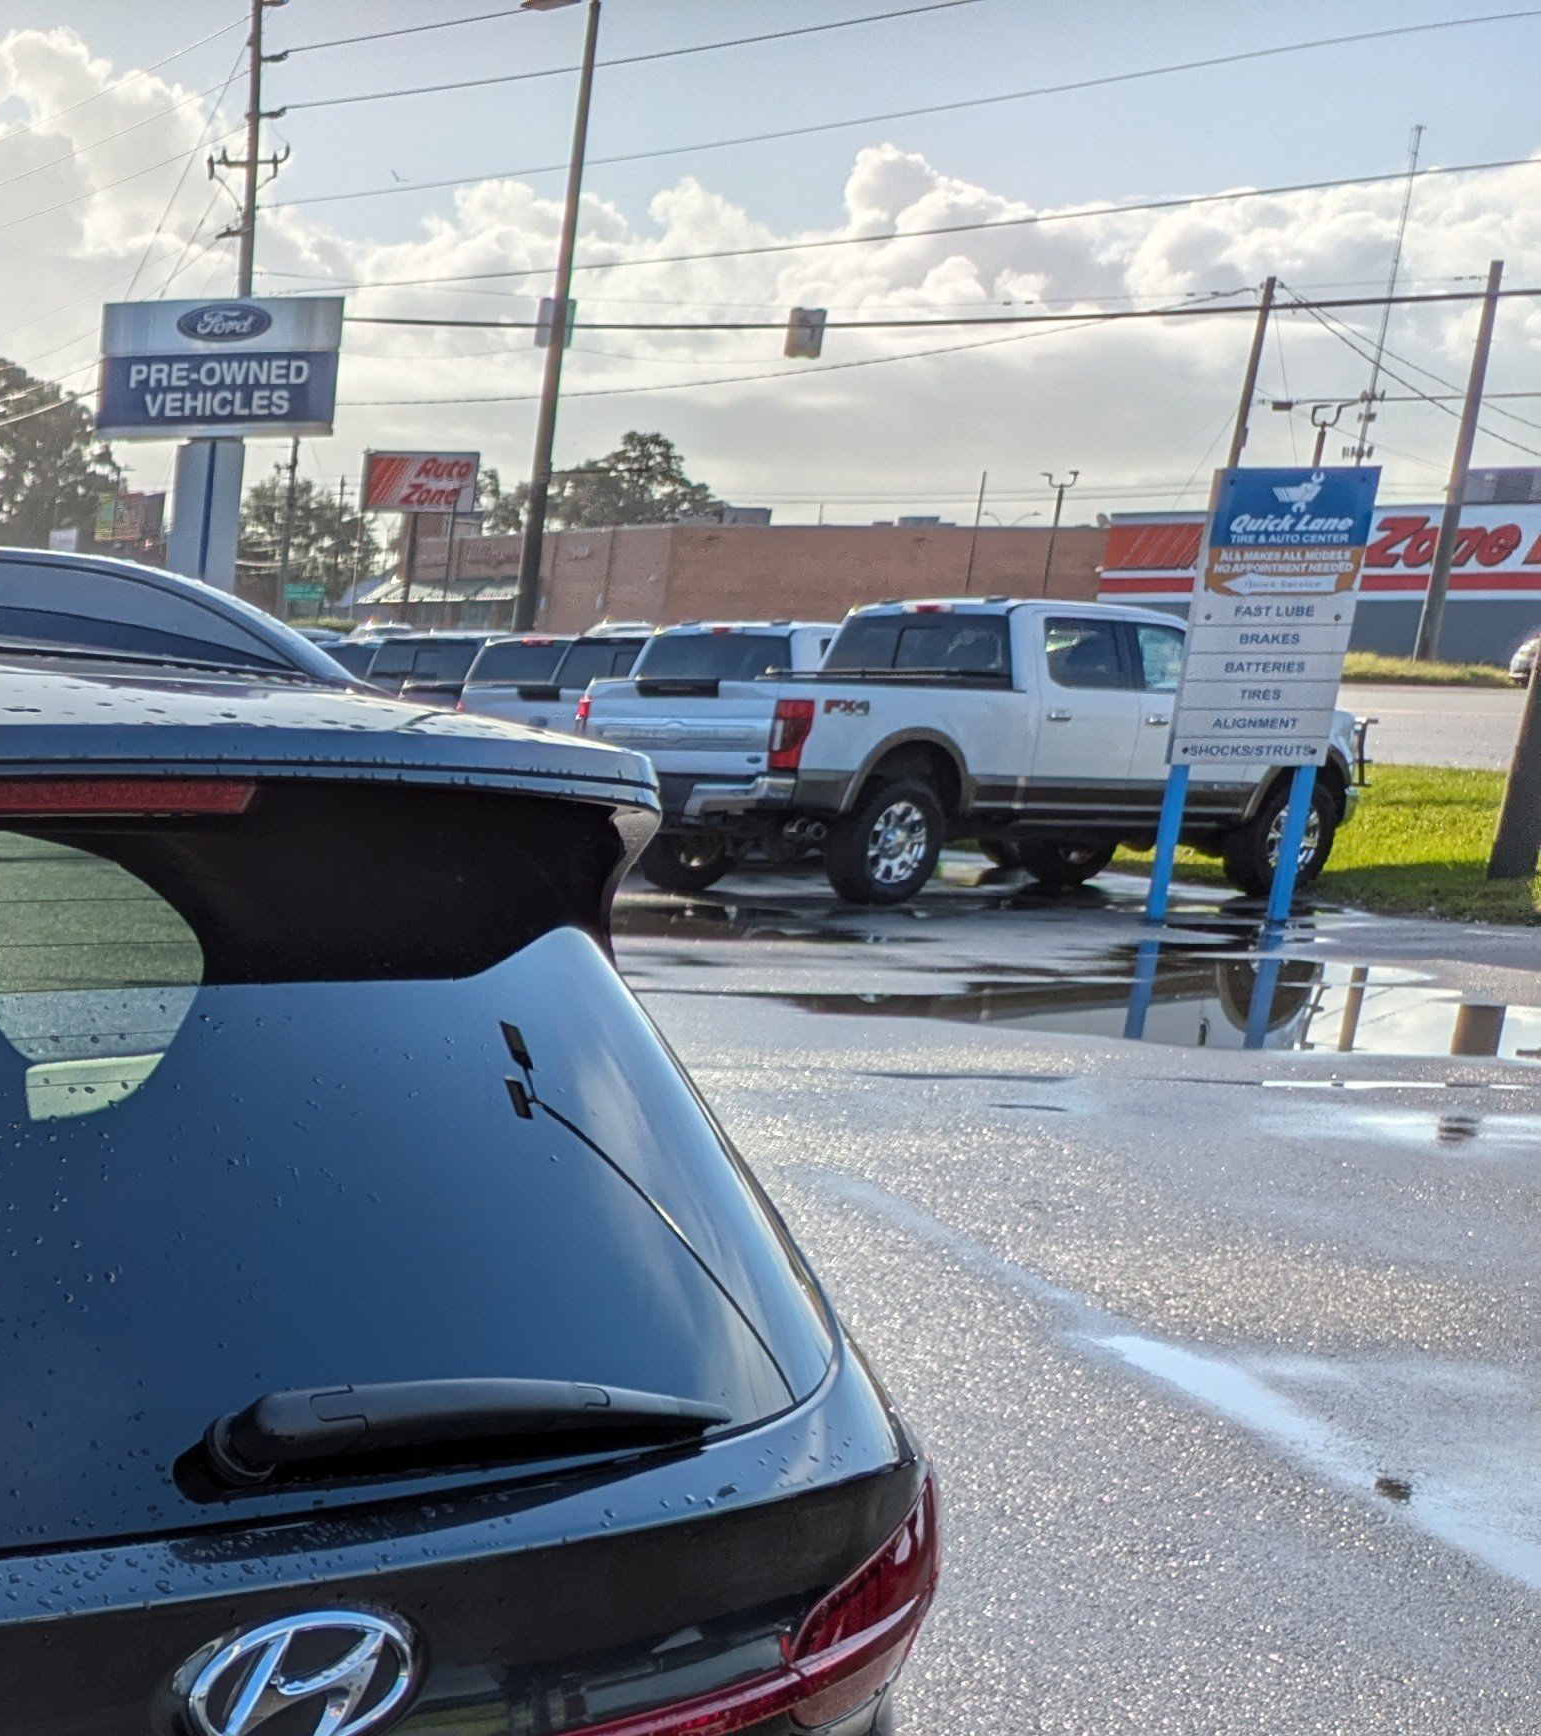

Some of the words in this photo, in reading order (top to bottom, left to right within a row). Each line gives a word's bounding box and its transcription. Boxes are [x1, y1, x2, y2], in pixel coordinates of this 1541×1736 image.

[196, 310, 257, 336] Ford
[128, 360, 309, 389] PRE-OWNED
[144, 390, 290, 418] VEHICLES
[416, 457, 473, 480] Auto
[398, 483, 462, 507] Zone
[1229, 514, 1292, 533] Quick
[1294, 513, 1354, 532] Lane
[1231, 534, 1255, 544] TIRE
[1258, 534, 1266, 544] &
[1268, 534, 1300, 544] AUTO
[1302, 533, 1350, 544] CENTER
[1365, 516, 1522, 568] Zone
[1220, 549, 1241, 561] ALL
[1243, 549, 1281, 561] MAKES
[1282, 549, 1303, 561] ALL
[1304, 549, 1351, 561] MODELS
[1213, 562, 1230, 573] NO
[1231, 562, 1307, 573] APPOINTMENT
[1308, 562, 1354, 573] NEEDED
[1234, 604, 1273, 617] FAST
[1276, 604, 1315, 617] LUBE
[1239, 633, 1300, 645] BRAKES
[1224, 661, 1305, 673] BATTERIES
[1239, 688, 1281, 701] TIRES
[1212, 717, 1299, 730] ALIGNMENT
[1190, 744, 1312, 757] SHOCKS/STRUTS
